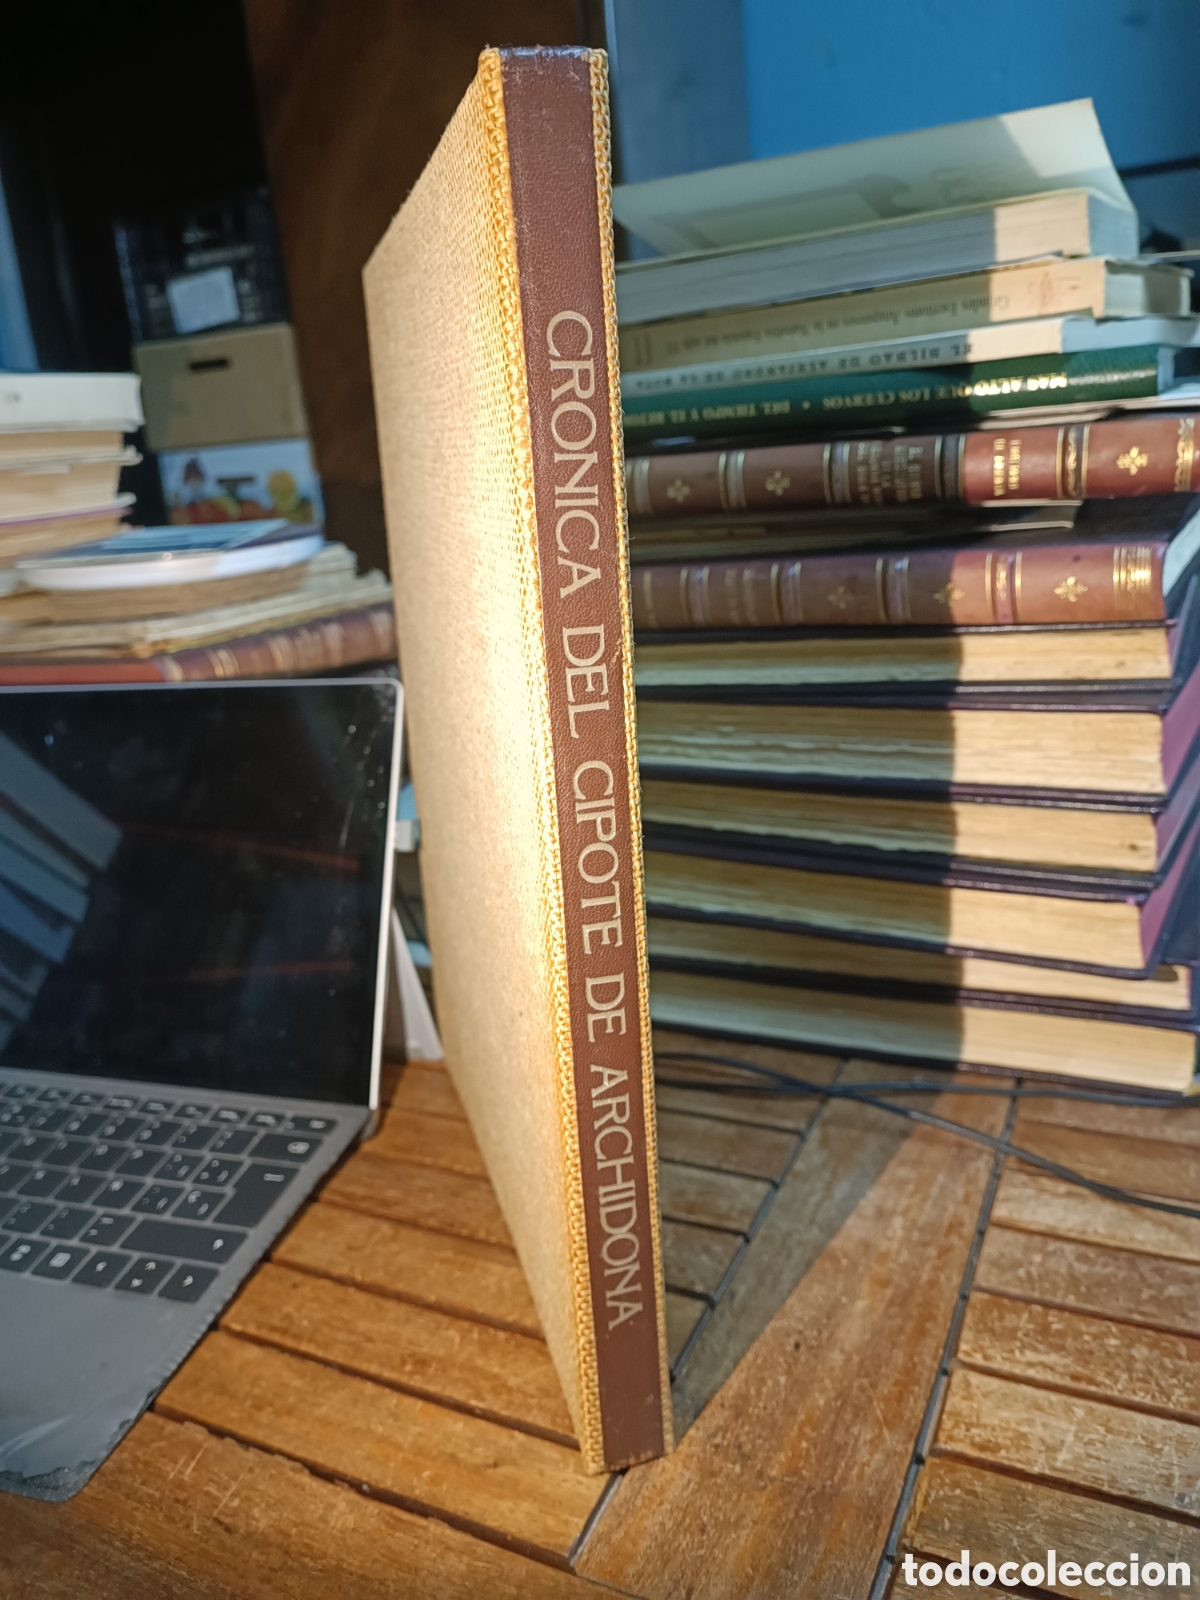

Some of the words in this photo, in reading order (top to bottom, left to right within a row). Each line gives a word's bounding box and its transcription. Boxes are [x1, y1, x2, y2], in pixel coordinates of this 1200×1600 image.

[869, 347, 941, 366] BILBAO
[900, 387, 930, 403] LOS
[546, 310, 601, 598] CRONICA
[562, 624, 610, 739] DEL
[573, 760, 624, 955] CIPOTE
[585, 972, 627, 1044] DE
[590, 1064, 643, 1331] ARCHIDONA
